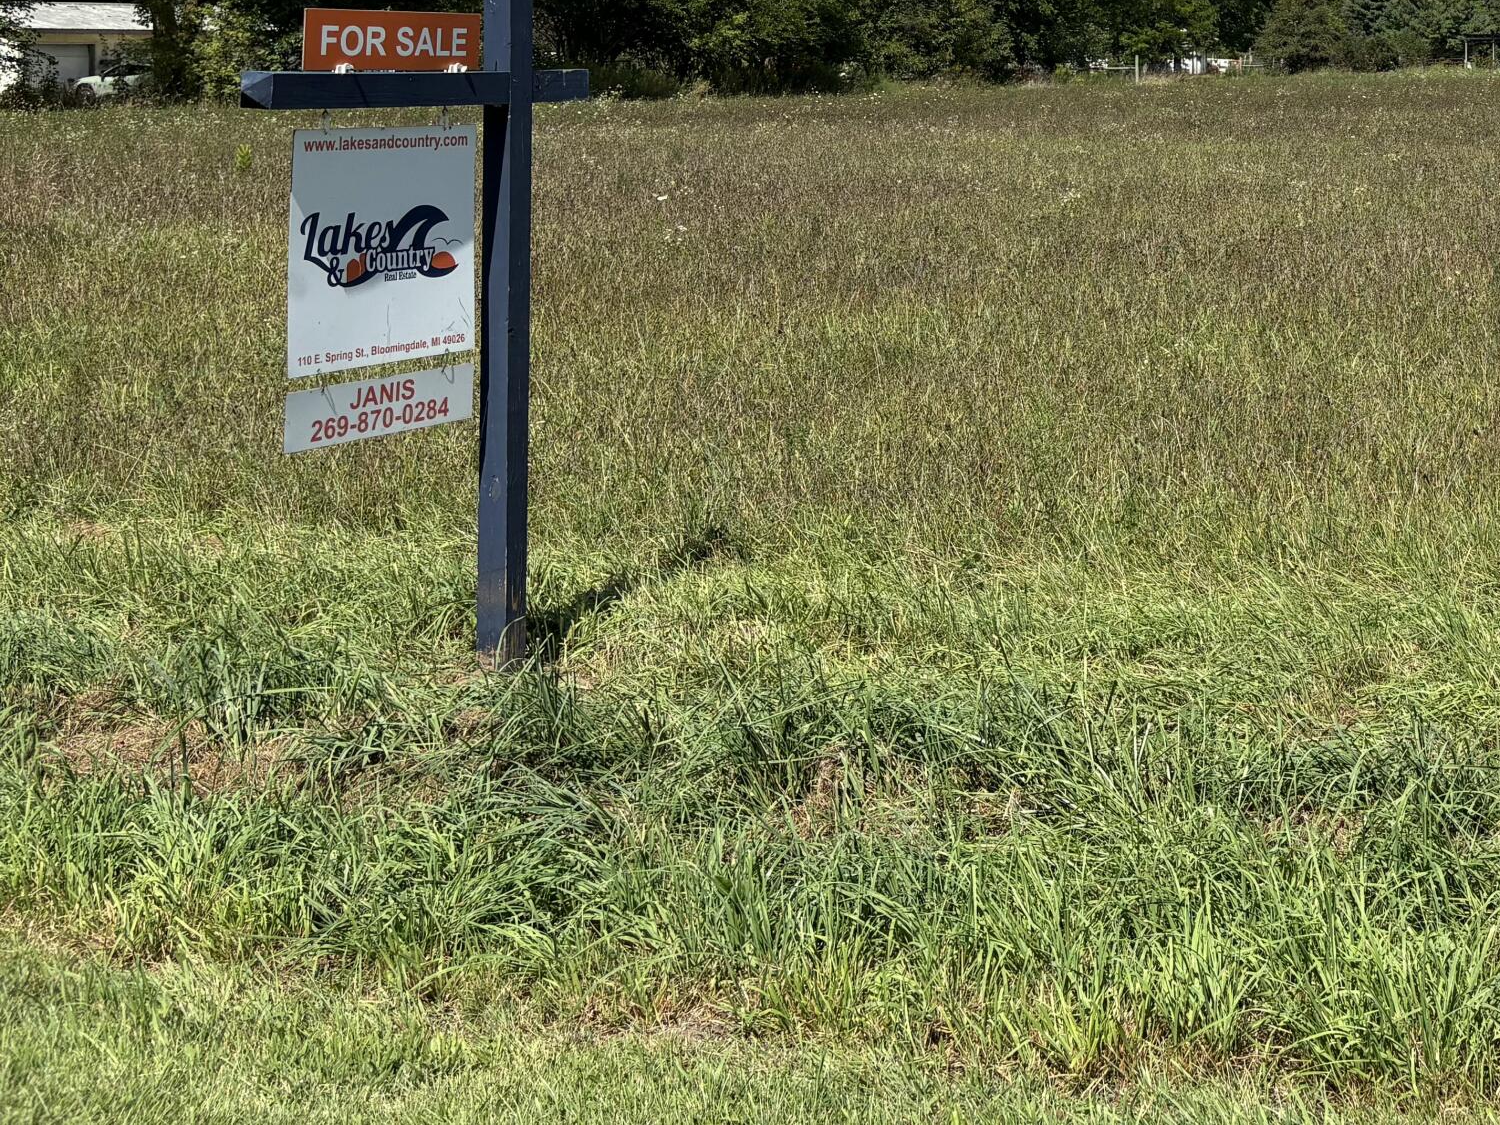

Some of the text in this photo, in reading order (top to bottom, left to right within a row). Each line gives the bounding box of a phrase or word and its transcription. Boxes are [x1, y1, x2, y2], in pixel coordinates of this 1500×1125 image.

[320, 25, 468, 57] FOR SALE
[303, 134, 469, 152] www.lakesandcountry.com
[300, 212, 395, 261] Lakes
[327, 246, 435, 287] & Country
[384, 270, 417, 282] Real Estate
[297, 333, 465, 366] 110 E. Spring St., Bloomingdale, MI 49026
[349, 378, 415, 409] JANIS
[310, 396, 450, 443] 269-870-0284
